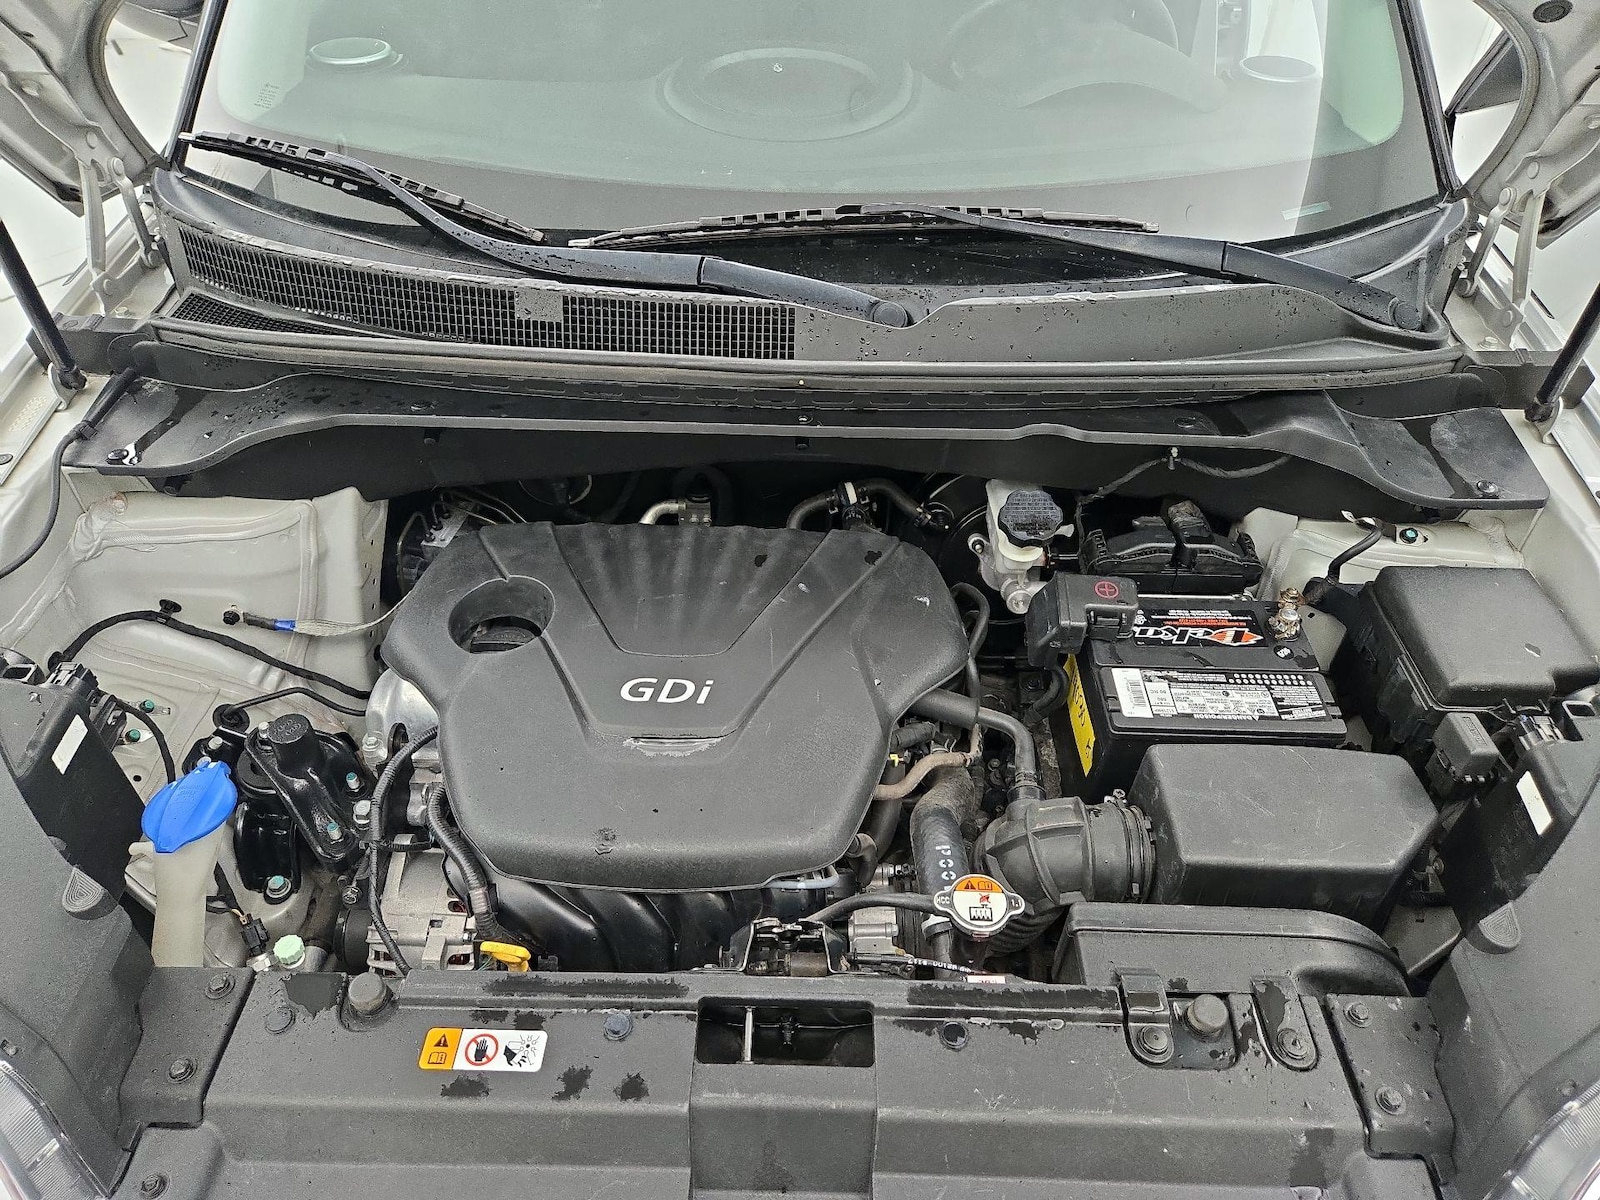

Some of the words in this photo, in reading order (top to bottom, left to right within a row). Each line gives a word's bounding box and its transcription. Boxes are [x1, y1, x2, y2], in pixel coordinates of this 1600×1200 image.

[1135, 626, 1263, 645] Deka
[619, 677, 714, 704] GDi
[936, 895, 951, 905] HCC
[1011, 898, 1022, 908] 1.1
